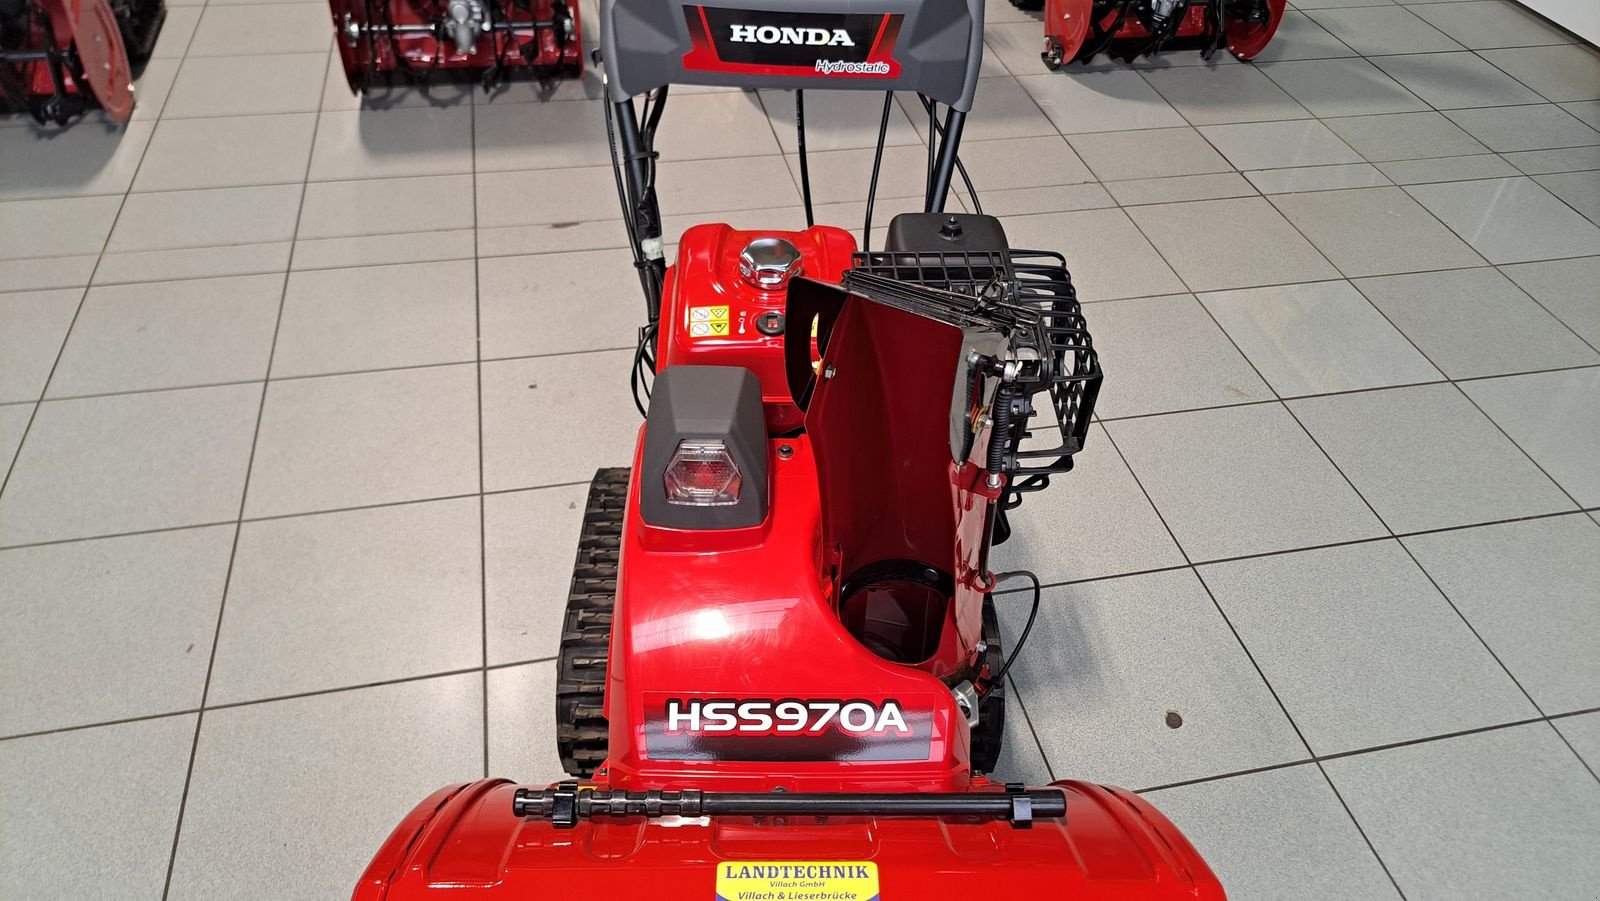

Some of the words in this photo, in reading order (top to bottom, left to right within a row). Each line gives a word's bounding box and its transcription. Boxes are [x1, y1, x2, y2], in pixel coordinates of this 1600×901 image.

[730, 24, 854, 46] HONDA
[815, 60, 889, 74] Hydrostatic
[667, 701, 908, 732] HSS970A
[725, 866, 870, 879] LANDTECHNIK
[738, 892, 774, 900] Villach
[777, 892, 786, 900] &
[788, 891, 857, 900] Lieserbrücke
